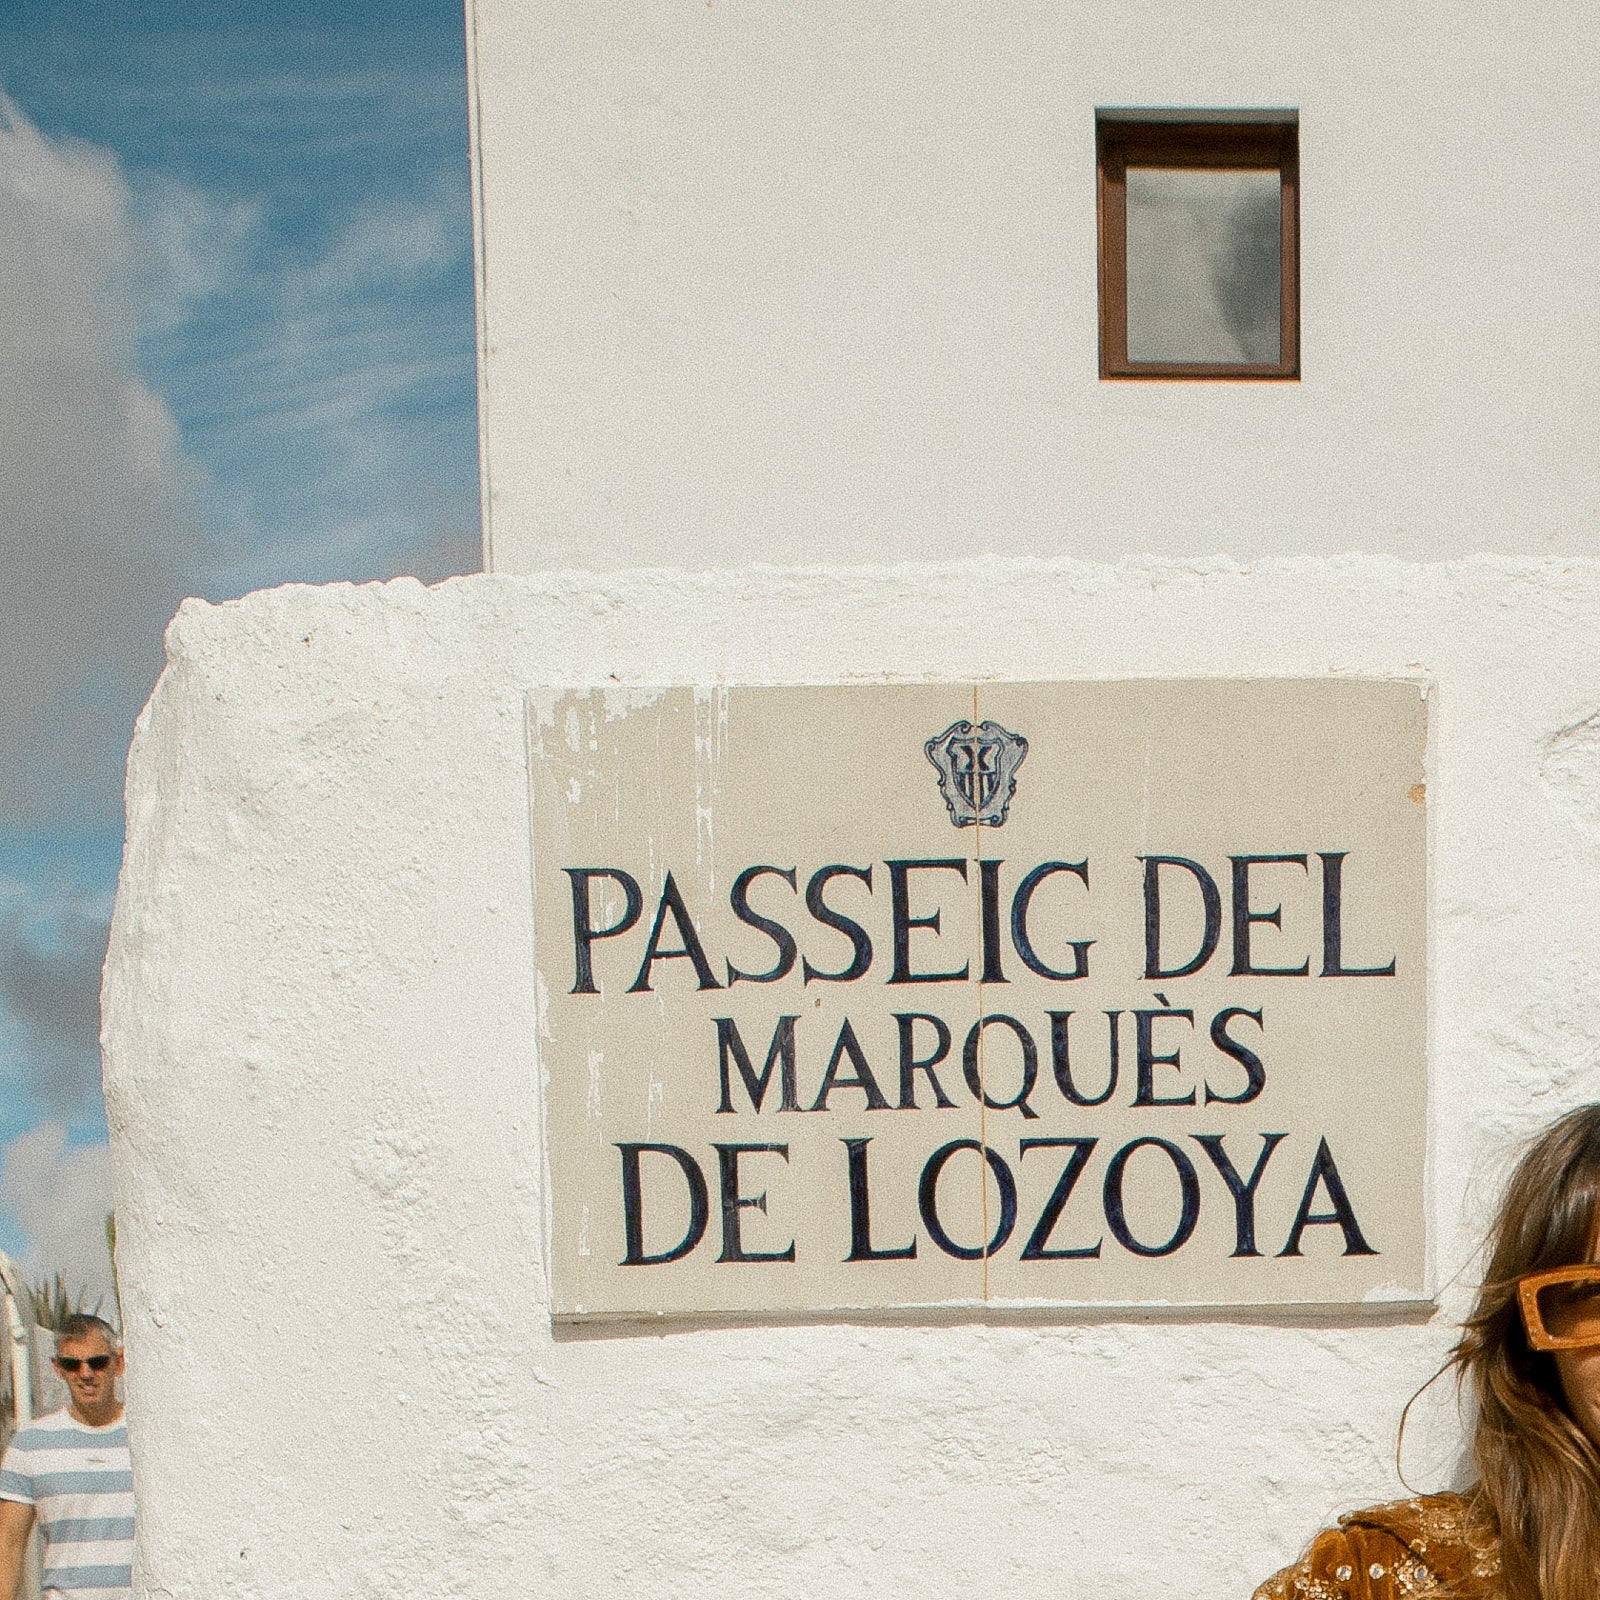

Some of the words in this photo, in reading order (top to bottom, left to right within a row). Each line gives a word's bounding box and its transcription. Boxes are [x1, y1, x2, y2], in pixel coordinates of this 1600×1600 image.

[561, 858, 1097, 994] PASSEIG
[1135, 852, 1396, 980] DEL
[711, 994, 1266, 1119] MARQUÈS
[612, 1143, 795, 1266] DE
[839, 1133, 1380, 1262] LOZOYA
